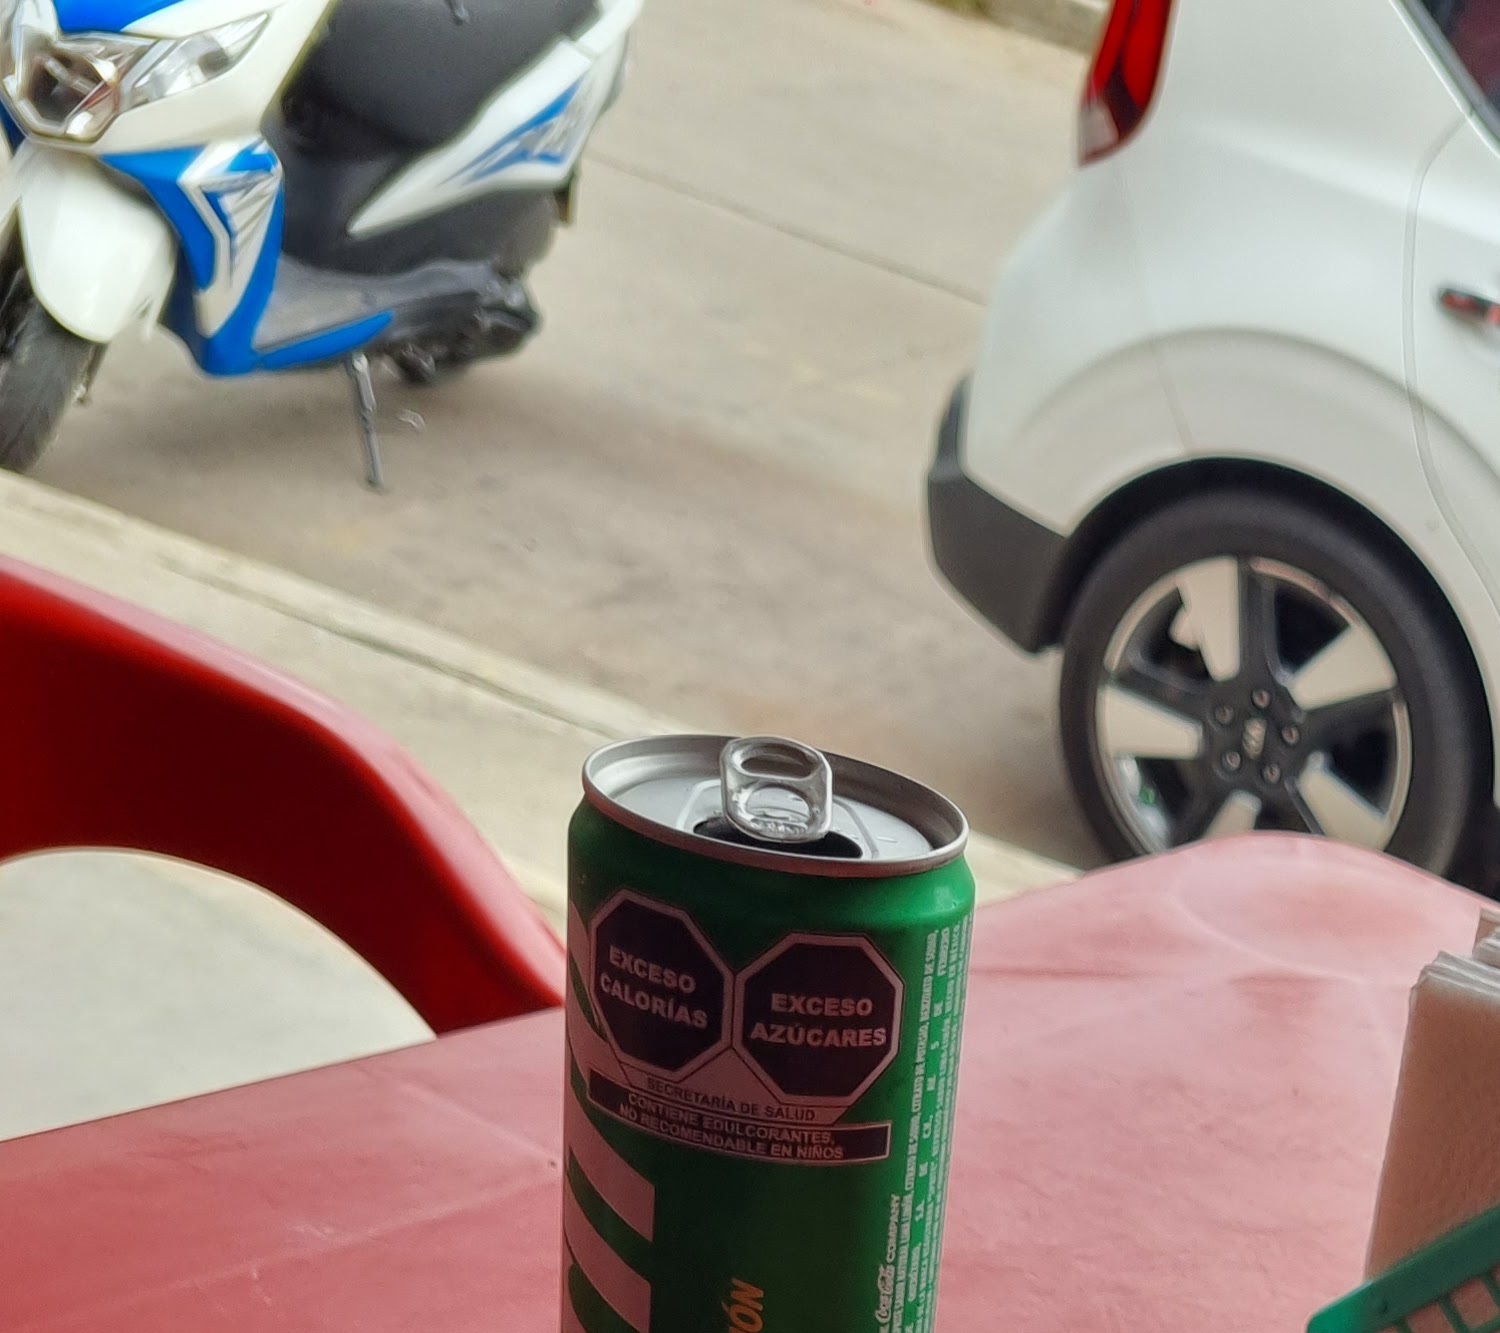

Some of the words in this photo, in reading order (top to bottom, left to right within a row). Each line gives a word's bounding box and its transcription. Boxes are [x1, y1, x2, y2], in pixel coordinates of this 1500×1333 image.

[609, 945, 696, 994] EXCESO
[600, 973, 708, 1030] CALORÍAS
[771, 993, 873, 1017] EXCESO
[751, 1022, 887, 1047] AZÚCARES
[629, 1093, 698, 1125] CONTIENE
[648, 1077, 736, 1111] SECRETARÍA
[740, 1103, 758, 1116] DE
[765, 1105, 815, 1121] SALUD
[620, 1102, 638, 1121] NO
[641, 1112, 766, 1155] RECOMENDABLE
[770, 1143, 792, 1158] EN
[797, 1142, 843, 1160] NIÑOS
[887, 1194, 900, 1263] COMPANY
